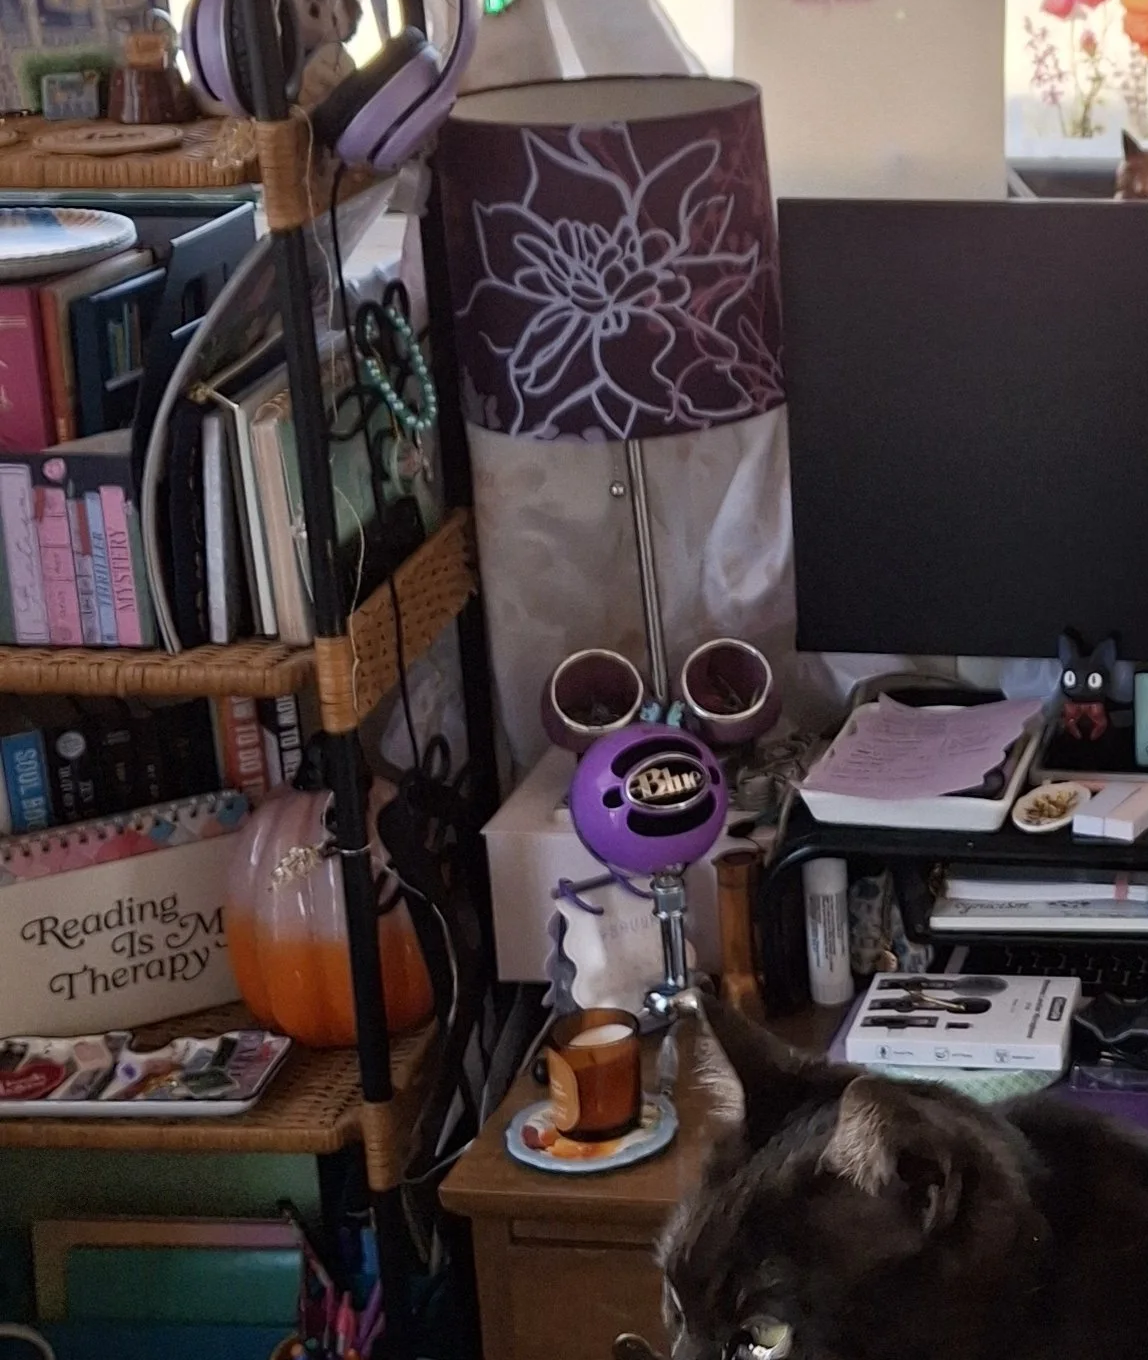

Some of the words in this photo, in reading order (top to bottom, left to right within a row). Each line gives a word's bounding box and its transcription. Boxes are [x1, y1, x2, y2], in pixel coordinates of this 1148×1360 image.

[108, 530, 136, 612] MYSTERY
[279, 727, 300, 749] TO
[14, 747, 42, 796] SOUL
[630, 767, 702, 799] Blue
[20, 893, 179, 950] Reading
[111, 930, 154, 958] Is
[165, 905, 229, 949] M
[49, 946, 210, 1001] Therapy
